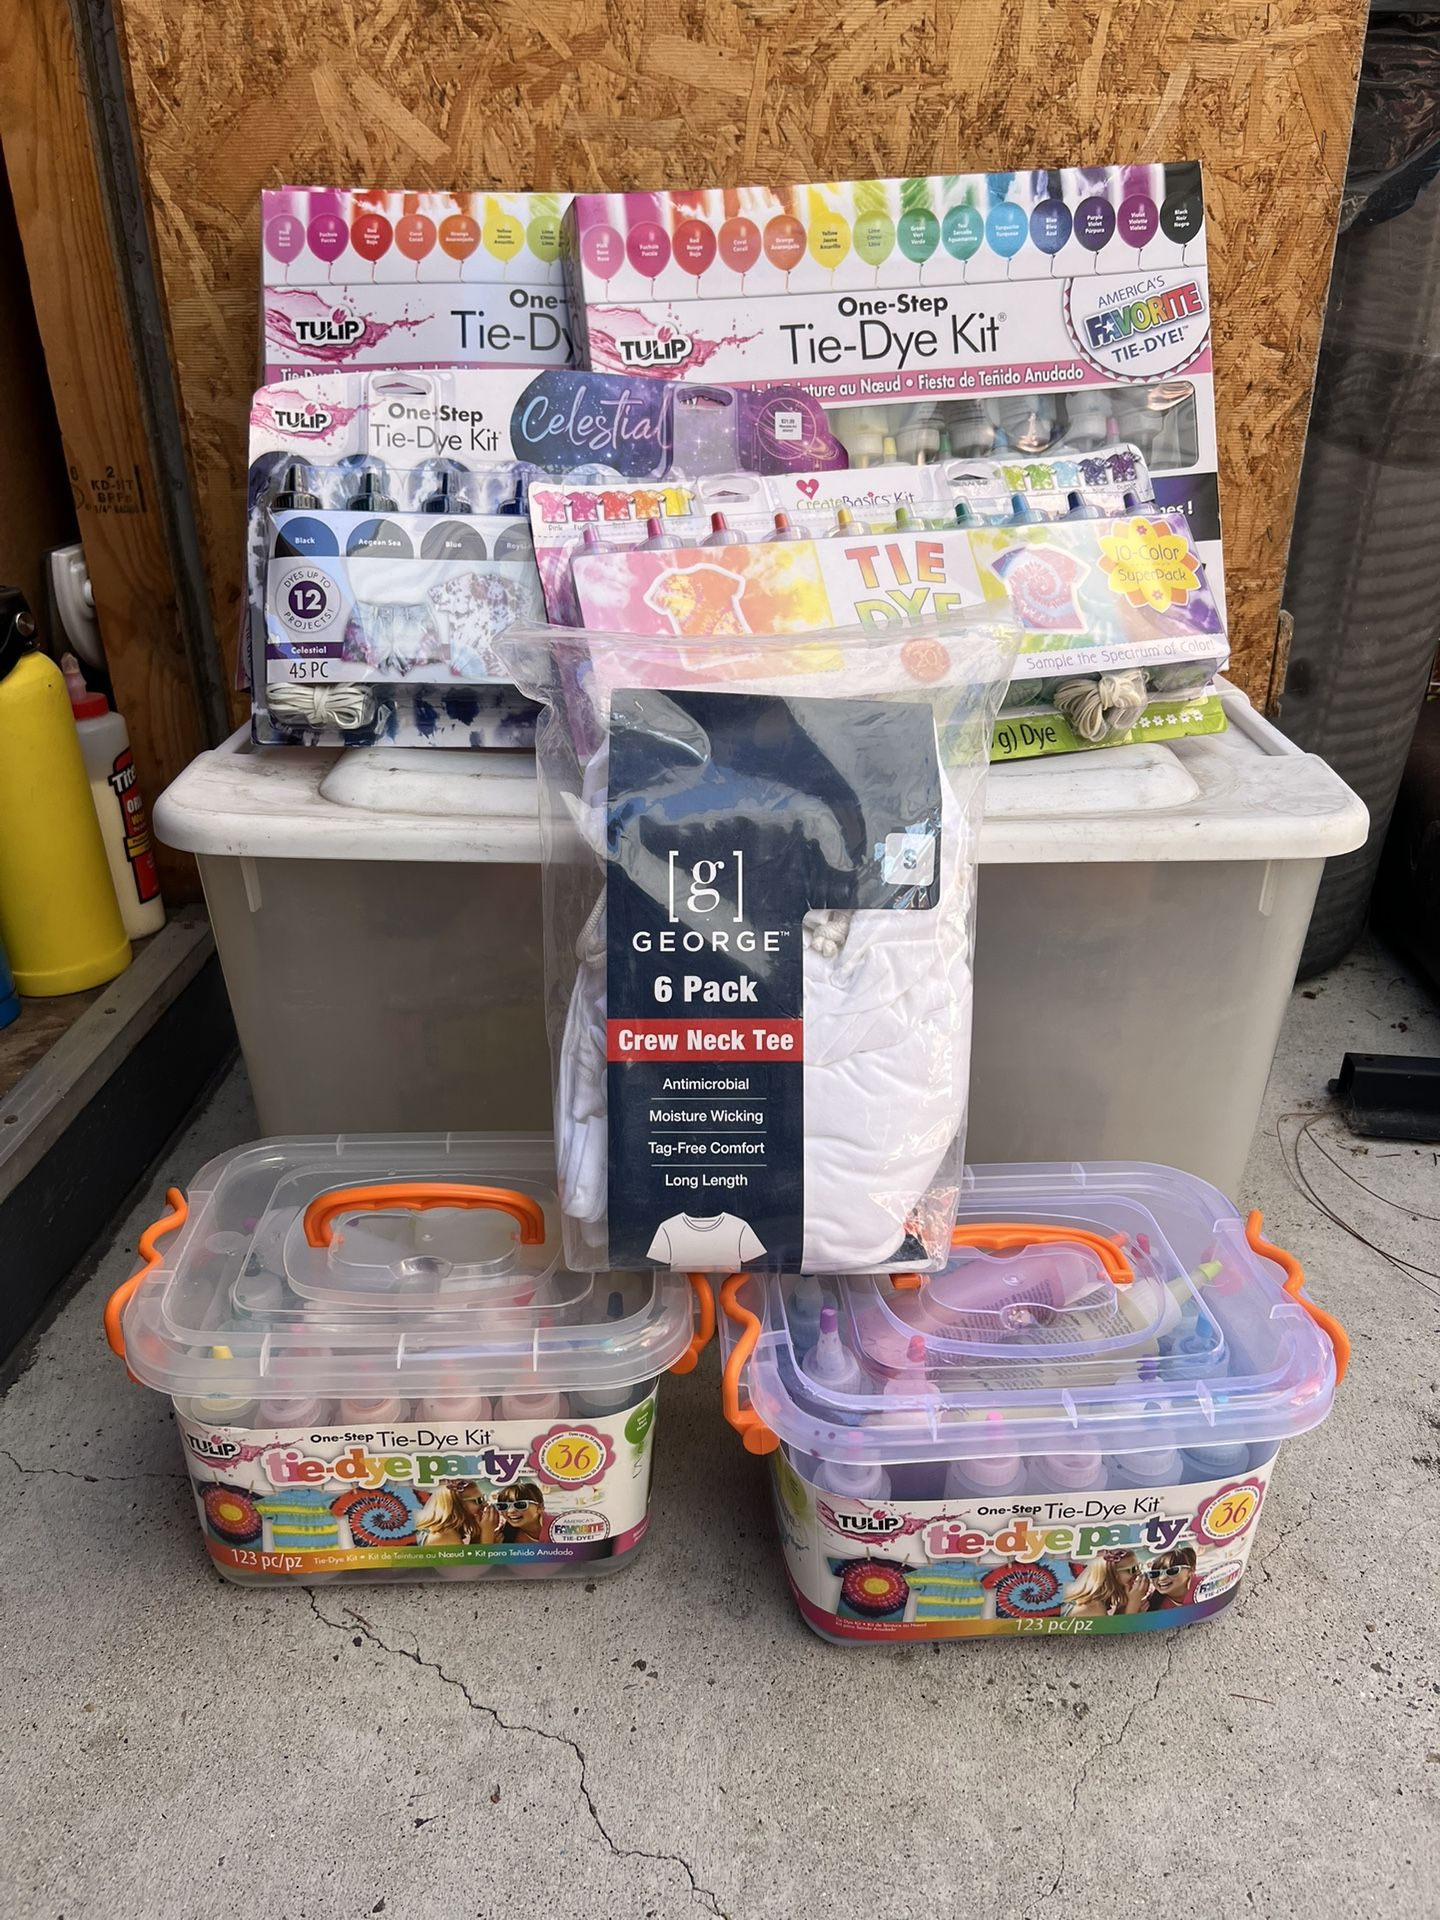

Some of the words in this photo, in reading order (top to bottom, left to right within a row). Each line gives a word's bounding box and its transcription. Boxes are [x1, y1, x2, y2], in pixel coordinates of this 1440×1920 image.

[1098, 275, 1165, 308] AMERICA'S
[838, 293, 948, 317] One-Step
[1085, 281, 1203, 348] FAVORITE
[296, 320, 360, 341] TULIP
[620, 339, 686, 361] TULIP
[780, 318, 938, 370] Tie-Dye
[840, 382, 856, 395] au
[860, 374, 901, 395] Nœud
[918, 372, 956, 391] Fiesta
[959, 372, 974, 388] de
[978, 368, 1020, 386] Teñido
[1024, 367, 1084, 384] Anudado
[274, 410, 328, 430] TULIP
[388, 402, 484, 424] One-Step
[521, 385, 672, 450] Celestial
[370, 424, 462, 456] Tie-Dye
[294, 536, 315, 544] Black
[358, 538, 384, 547] Aegean
[388, 538, 401, 546] Sea
[444, 540, 462, 548] Blue
[1115, 544, 1180, 560] 10-Color
[844, 541, 946, 589] TIE
[1118, 568, 1186, 583] SuperPack
[284, 571, 304, 589] DYES
[306, 570, 319, 579] UP
[319, 575, 332, 590] TO
[294, 589, 322, 610] 12
[284, 608, 334, 630] PROJECTS!
[854, 587, 966, 635] DYE
[291, 646, 327, 654] Celestial
[1026, 657, 1074, 671] Sample
[1078, 653, 1098, 664] the
[1102, 646, 1160, 664] Spectrum
[1164, 642, 1176, 655] of
[289, 662, 307, 678] 45
[311, 660, 328, 678] PC
[1022, 723, 1058, 750] Dye
[902, 849, 917, 869] S
[654, 976, 673, 1003] 6
[684, 975, 758, 1003] Pack
[618, 1029, 678, 1050] Crew
[686, 1029, 744, 1050] Neck
[752, 1030, 794, 1050] Tee
[662, 1078, 750, 1090] Antimicrobial
[650, 1110, 708, 1122] Moisture
[710, 1110, 764, 1125] Wicking
[648, 1142, 707, 1156] Tag-Free
[711, 1141, 766, 1154] Comfort
[665, 1174, 698, 1188] Long
[702, 1174, 748, 1188] Length
[187, 1434, 236, 1456] TULIP
[310, 1432, 374, 1444] One-Step
[376, 1430, 459, 1450] Tie-Dye
[266, 1448, 412, 1486] tie-dye
[416, 1448, 524, 1483] party
[555, 1444, 590, 1470] 36
[977, 1504, 1042, 1516] One-Step
[1044, 1500, 1126, 1520] Tie-Dye
[1215, 1496, 1250, 1528] 36
[838, 1514, 898, 1531] TULIP
[927, 1521, 1074, 1560] tie-dye
[1078, 1516, 1188, 1556] party
[232, 1548, 258, 1566] 123
[261, 1554, 303, 1572] pc/pz
[314, 1556, 346, 1565] Tie-Dye
[475, 1549, 486, 1557] Kit
[509, 1548, 535, 1556] Teñido
[536, 1548, 574, 1556] Anudado
[1015, 1618, 1044, 1631] 123
[1047, 1617, 1094, 1634] pc/pz
